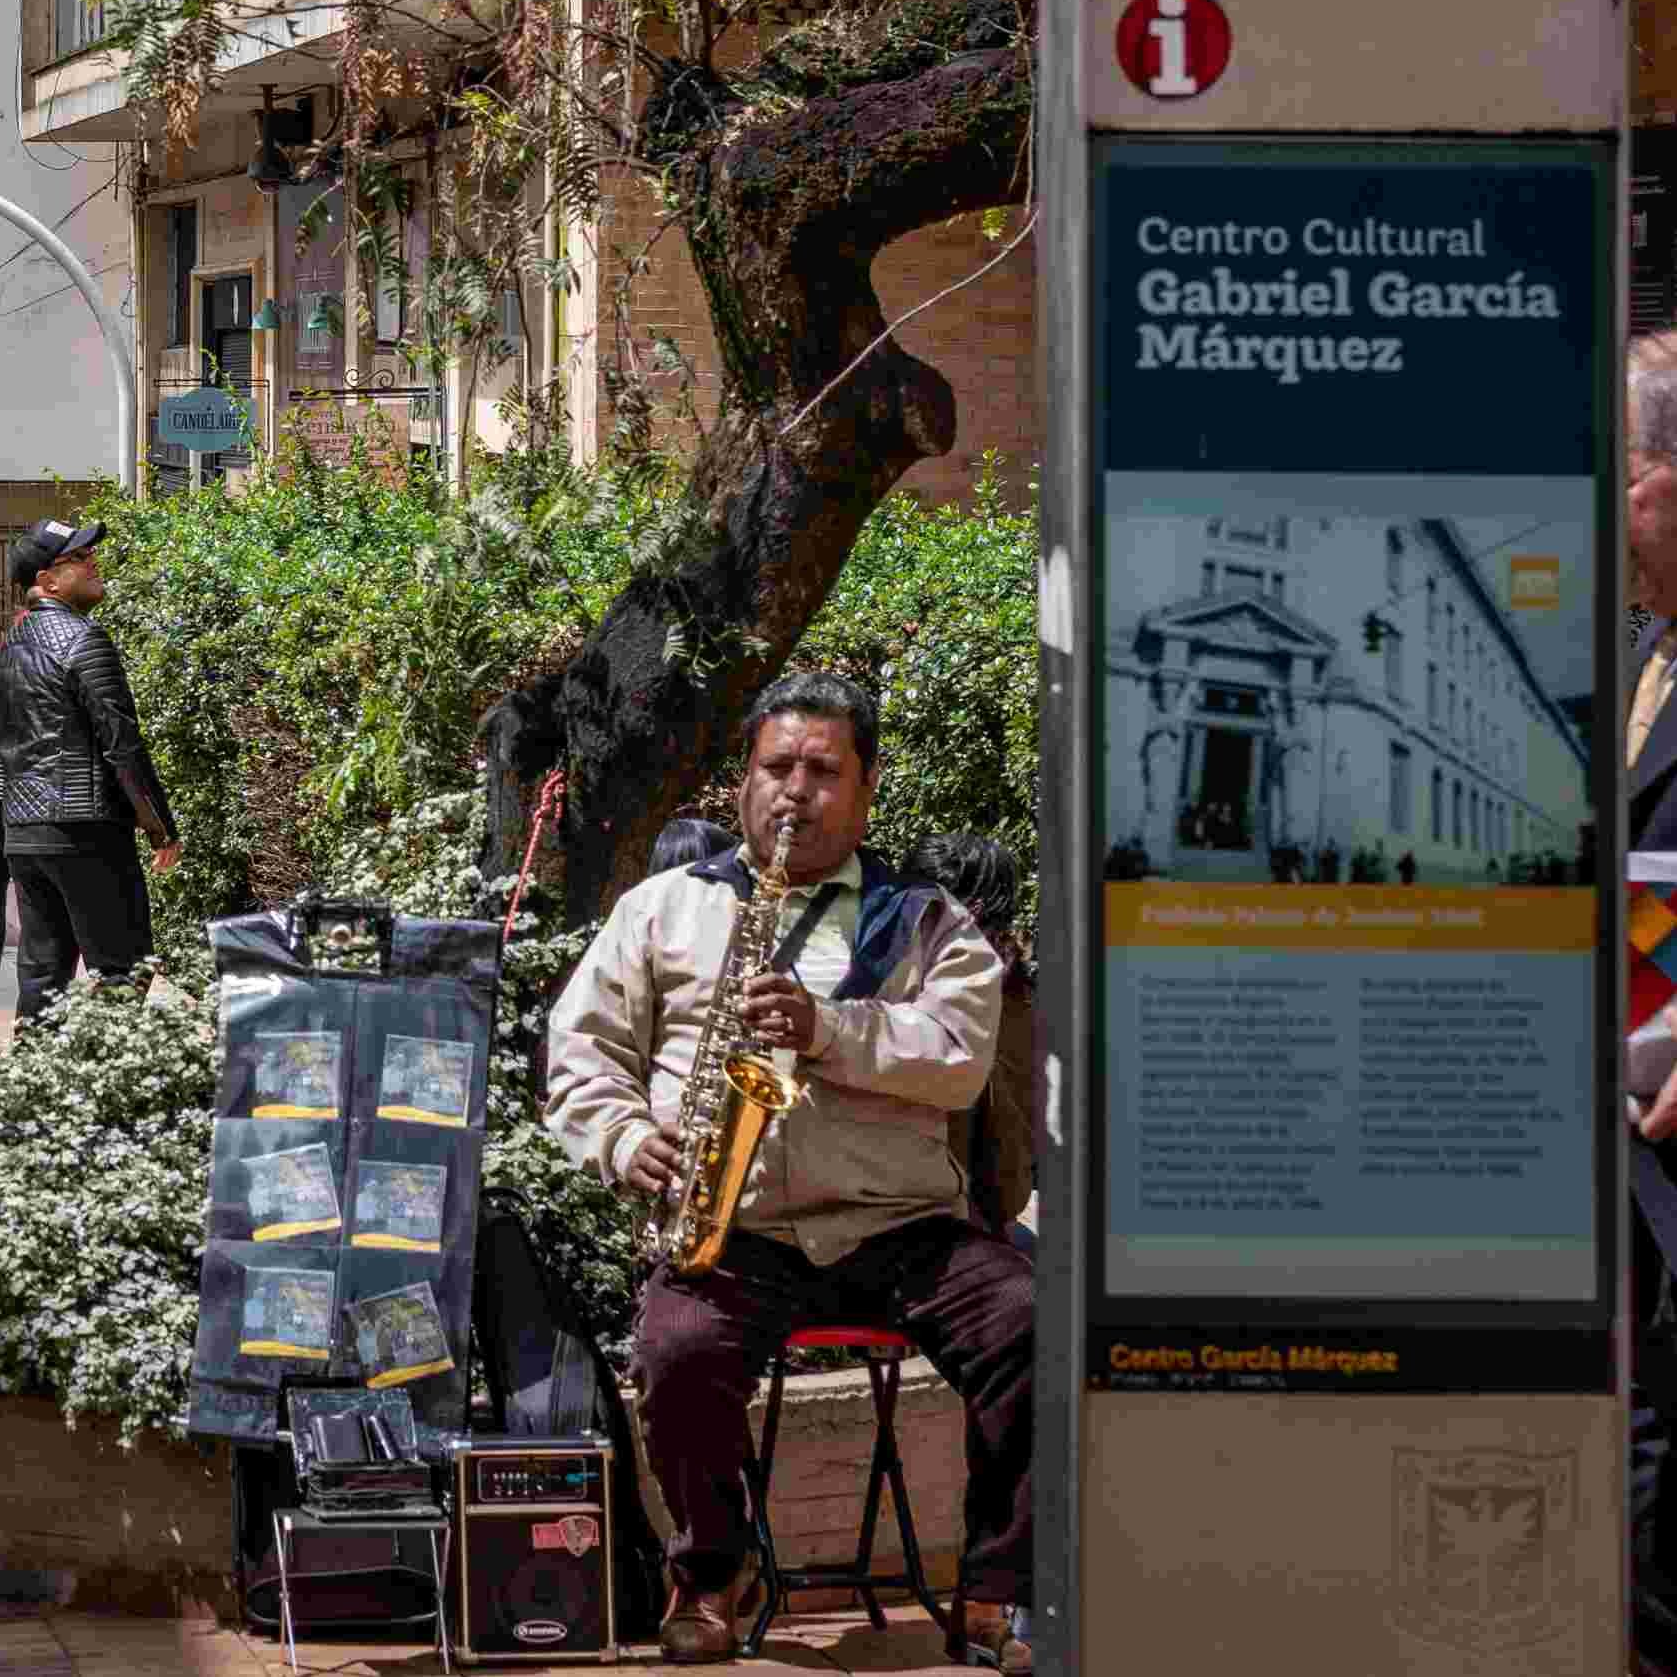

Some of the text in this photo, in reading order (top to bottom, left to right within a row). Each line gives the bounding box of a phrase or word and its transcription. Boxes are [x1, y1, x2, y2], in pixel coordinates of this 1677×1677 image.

[1137, 216, 1485, 257] Centro Cultural
[1136, 268, 1559, 319] Gabriel García
[1136, 323, 1404, 384] Márquez
